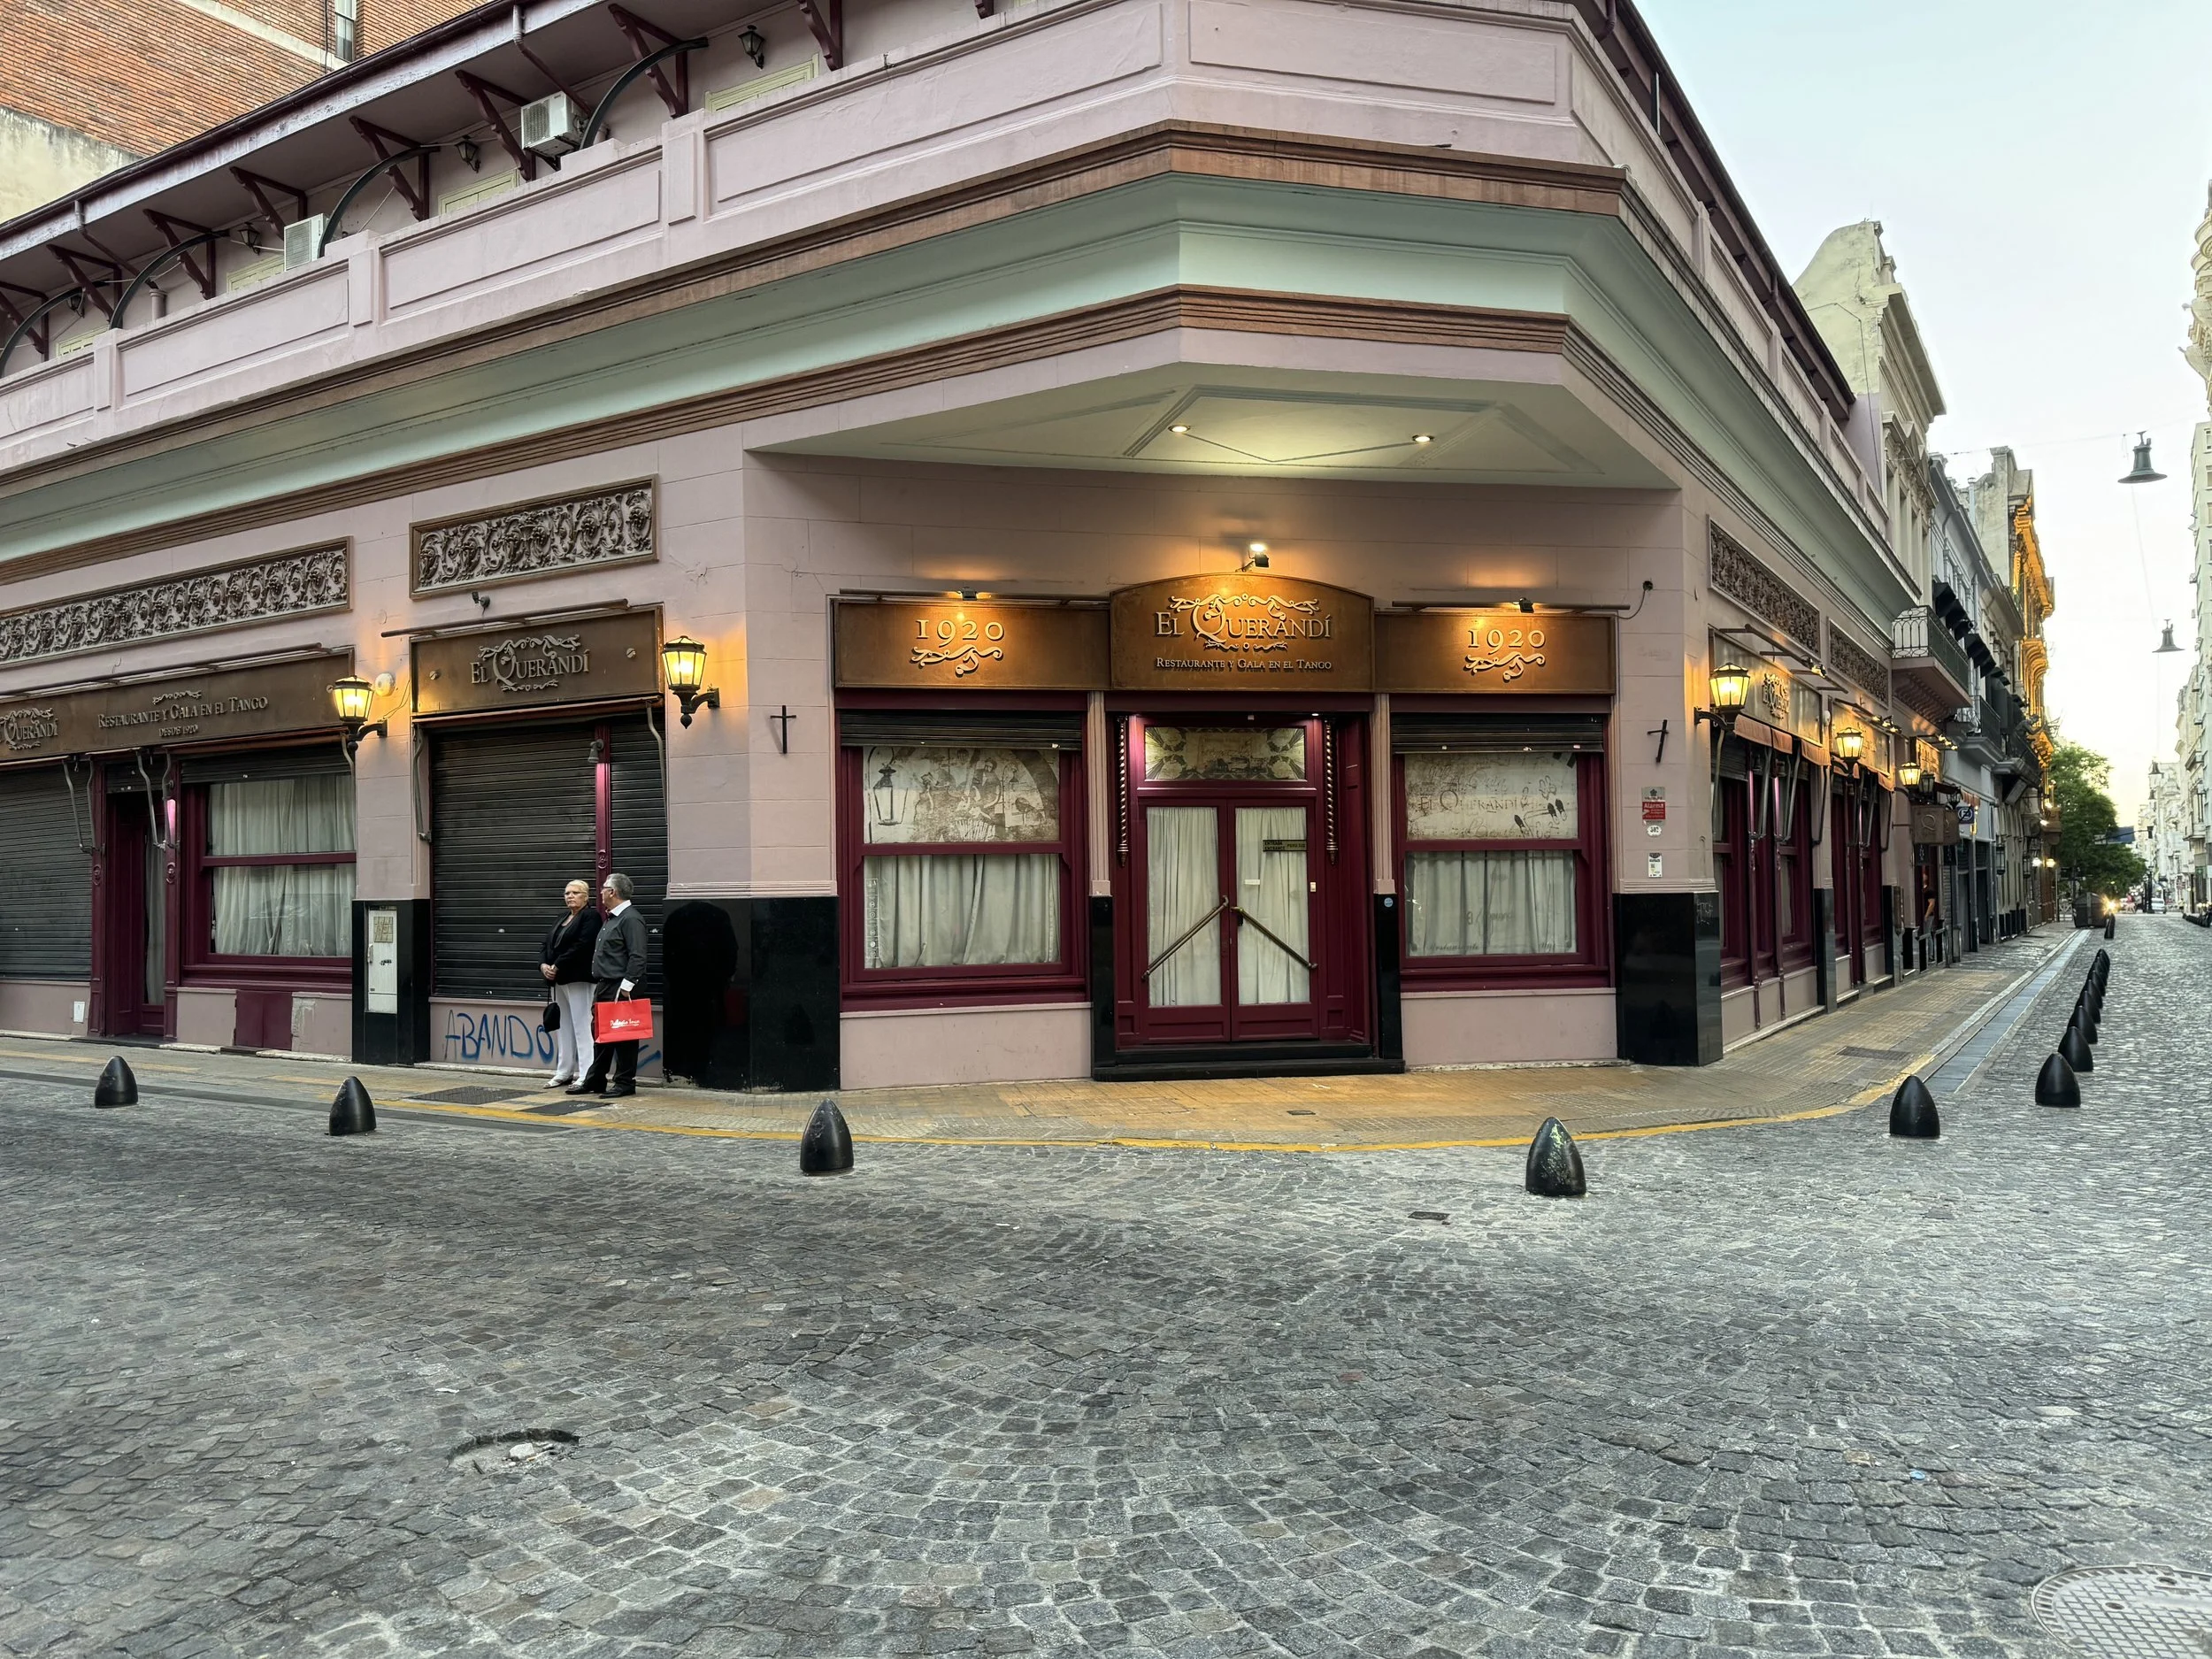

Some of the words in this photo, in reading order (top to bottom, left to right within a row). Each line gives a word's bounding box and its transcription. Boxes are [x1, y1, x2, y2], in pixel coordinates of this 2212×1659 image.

[915, 618, 1004, 648] 1920
[1155, 611, 1185, 636] EL
[1468, 629, 1547, 655] 1920
[470, 662, 488, 684] EL
[1156, 657, 1225, 669] RESTAURANTE
[1237, 658, 1266, 670] GALA
[1297, 658, 1332, 671] TANGO
[228, 696, 269, 713] TANGO
[444, 1009, 559, 1064] ABANDO
